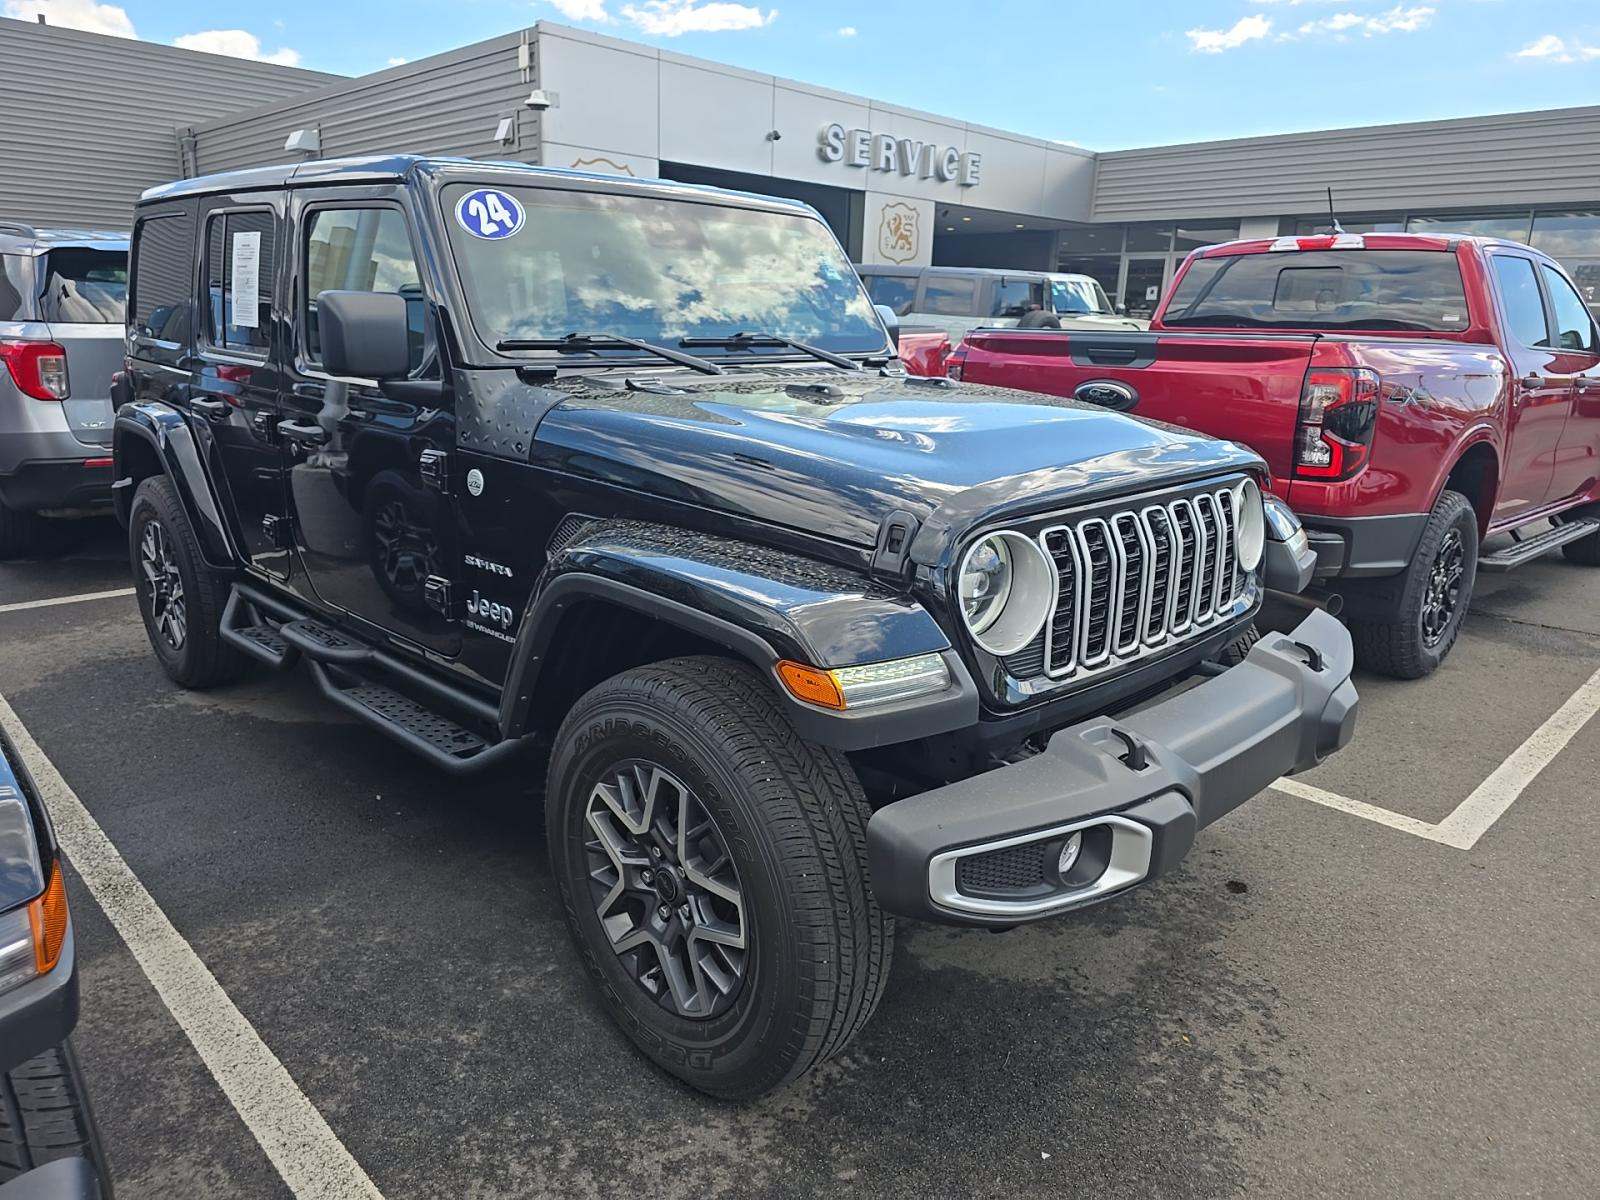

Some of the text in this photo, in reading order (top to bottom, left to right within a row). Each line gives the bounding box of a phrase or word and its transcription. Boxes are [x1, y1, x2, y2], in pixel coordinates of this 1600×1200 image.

[817, 123, 982, 186] SERVICE
[468, 193, 515, 236] 24
[466, 589, 513, 629] Jeep
[574, 717, 756, 864] BRIDGESTONE
